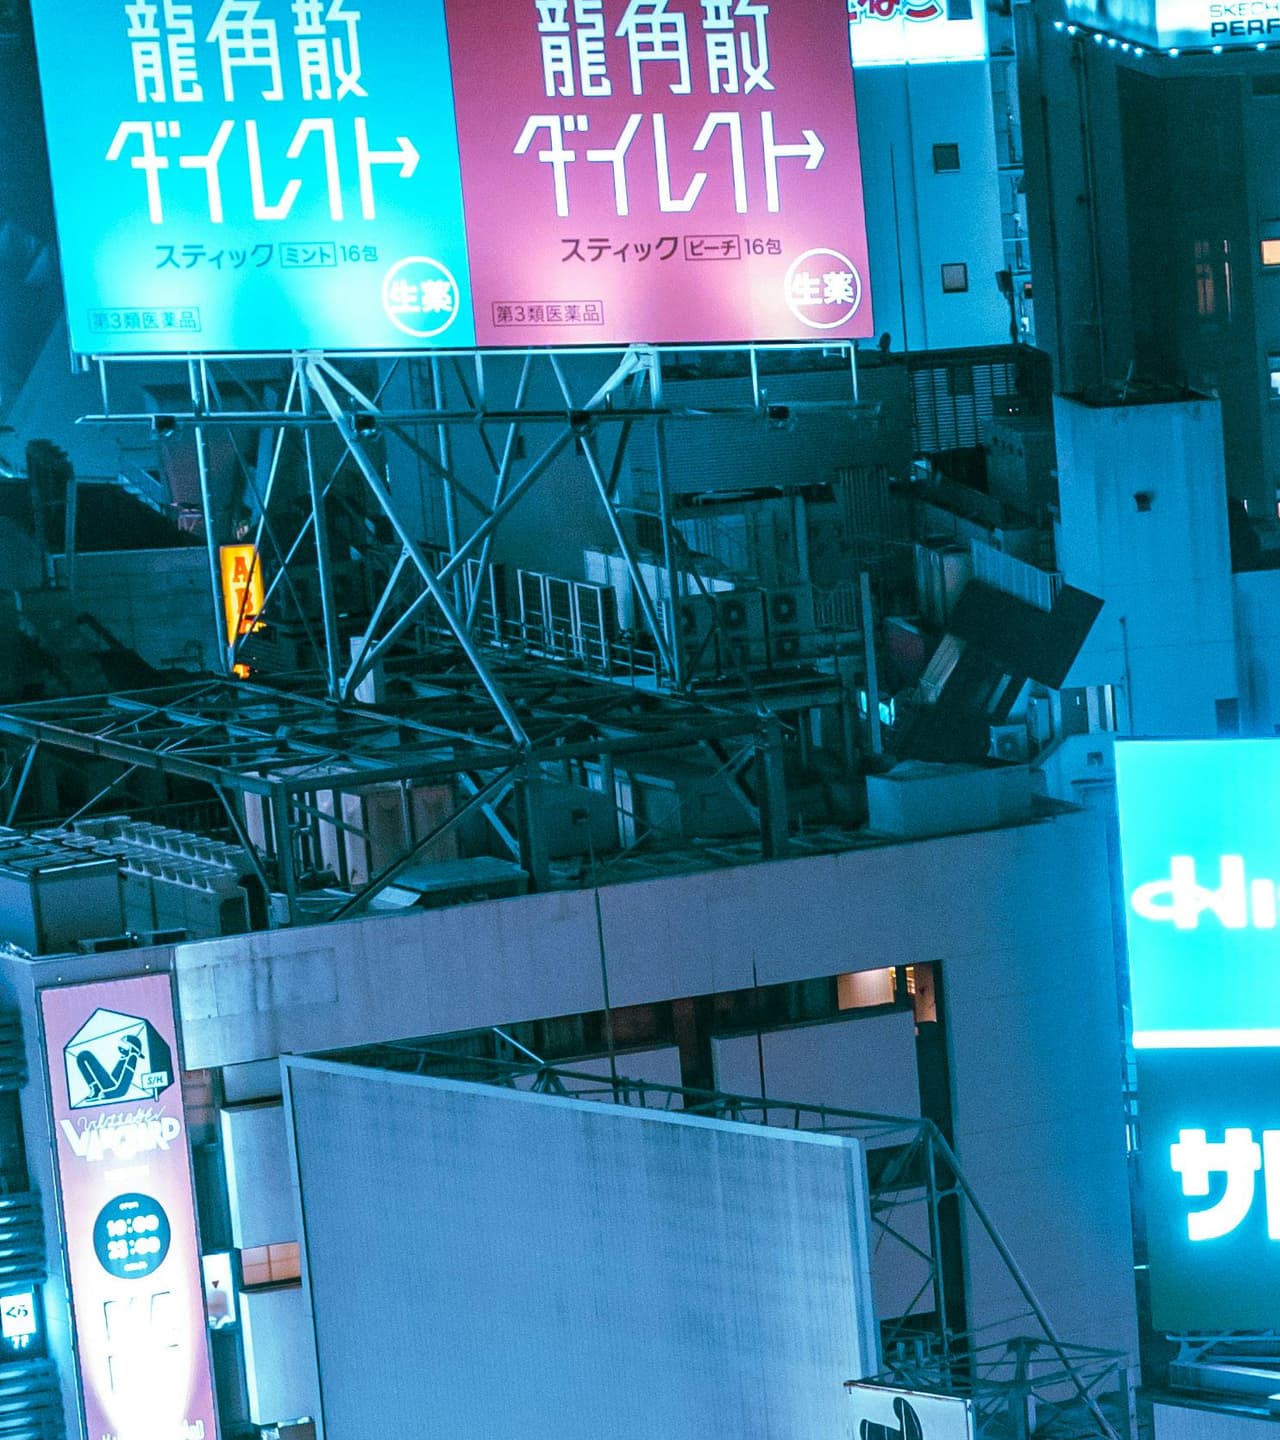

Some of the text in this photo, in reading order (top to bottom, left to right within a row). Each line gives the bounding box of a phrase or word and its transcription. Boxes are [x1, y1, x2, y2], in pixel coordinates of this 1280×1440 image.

[127, 0, 368, 103] 龍角散
[538, 0, 776, 97] 龍角散
[105, 116, 421, 224] ダイレクト
[513, 111, 825, 217] ダイレクト
[155, 243, 378, 269] スティック ミント 16包
[561, 236, 678, 264] スティック
[744, 237, 782, 258] 16包
[91, 309, 198, 331] 第3類医薬品
[496, 303, 601, 325] 第3類医薬品
